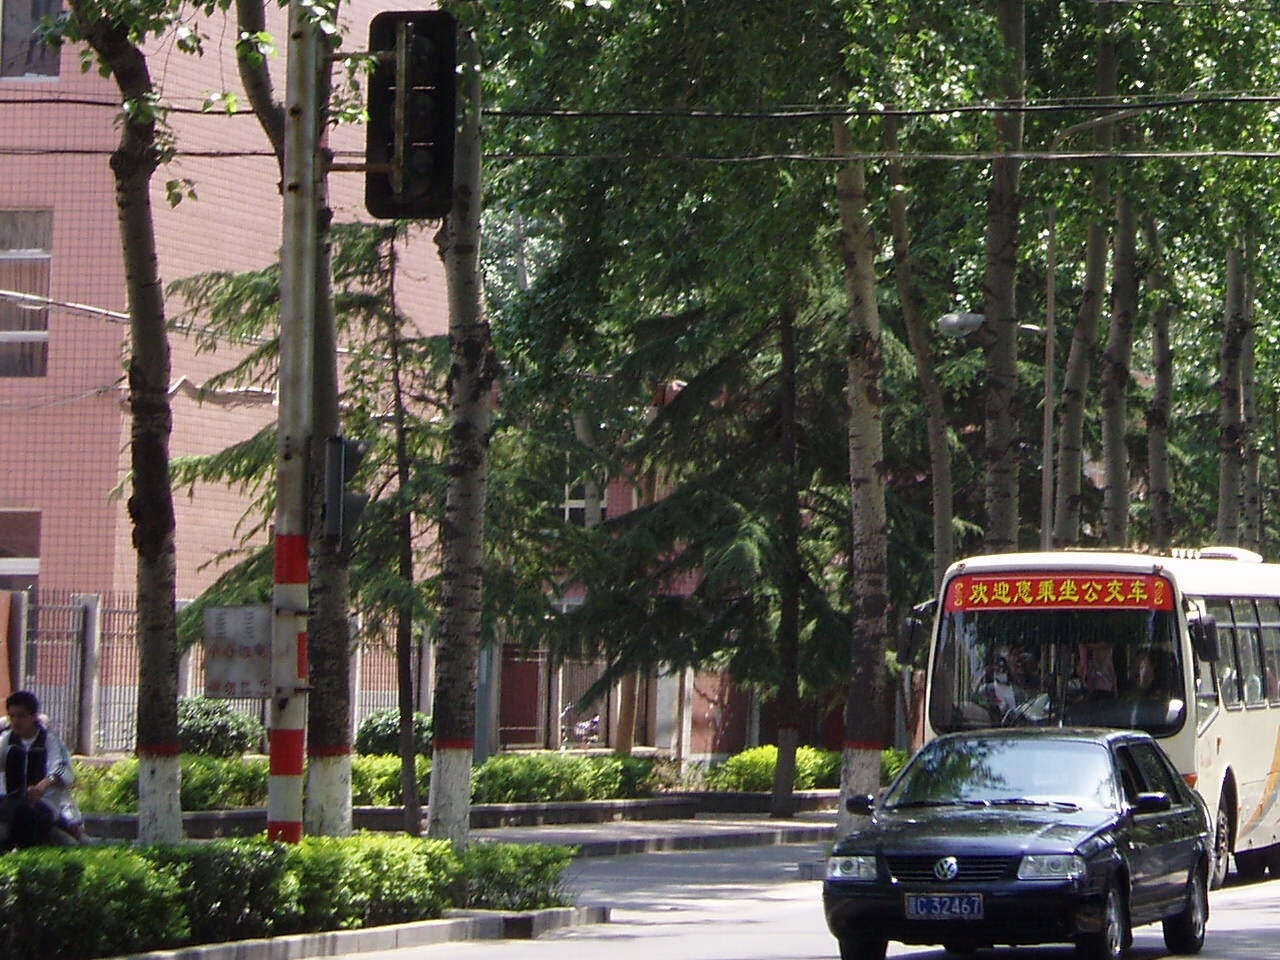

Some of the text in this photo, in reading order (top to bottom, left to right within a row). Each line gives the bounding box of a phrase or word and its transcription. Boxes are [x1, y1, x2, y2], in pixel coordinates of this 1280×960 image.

[968, 579, 1148, 604] 欢迎您乘坐公交车
